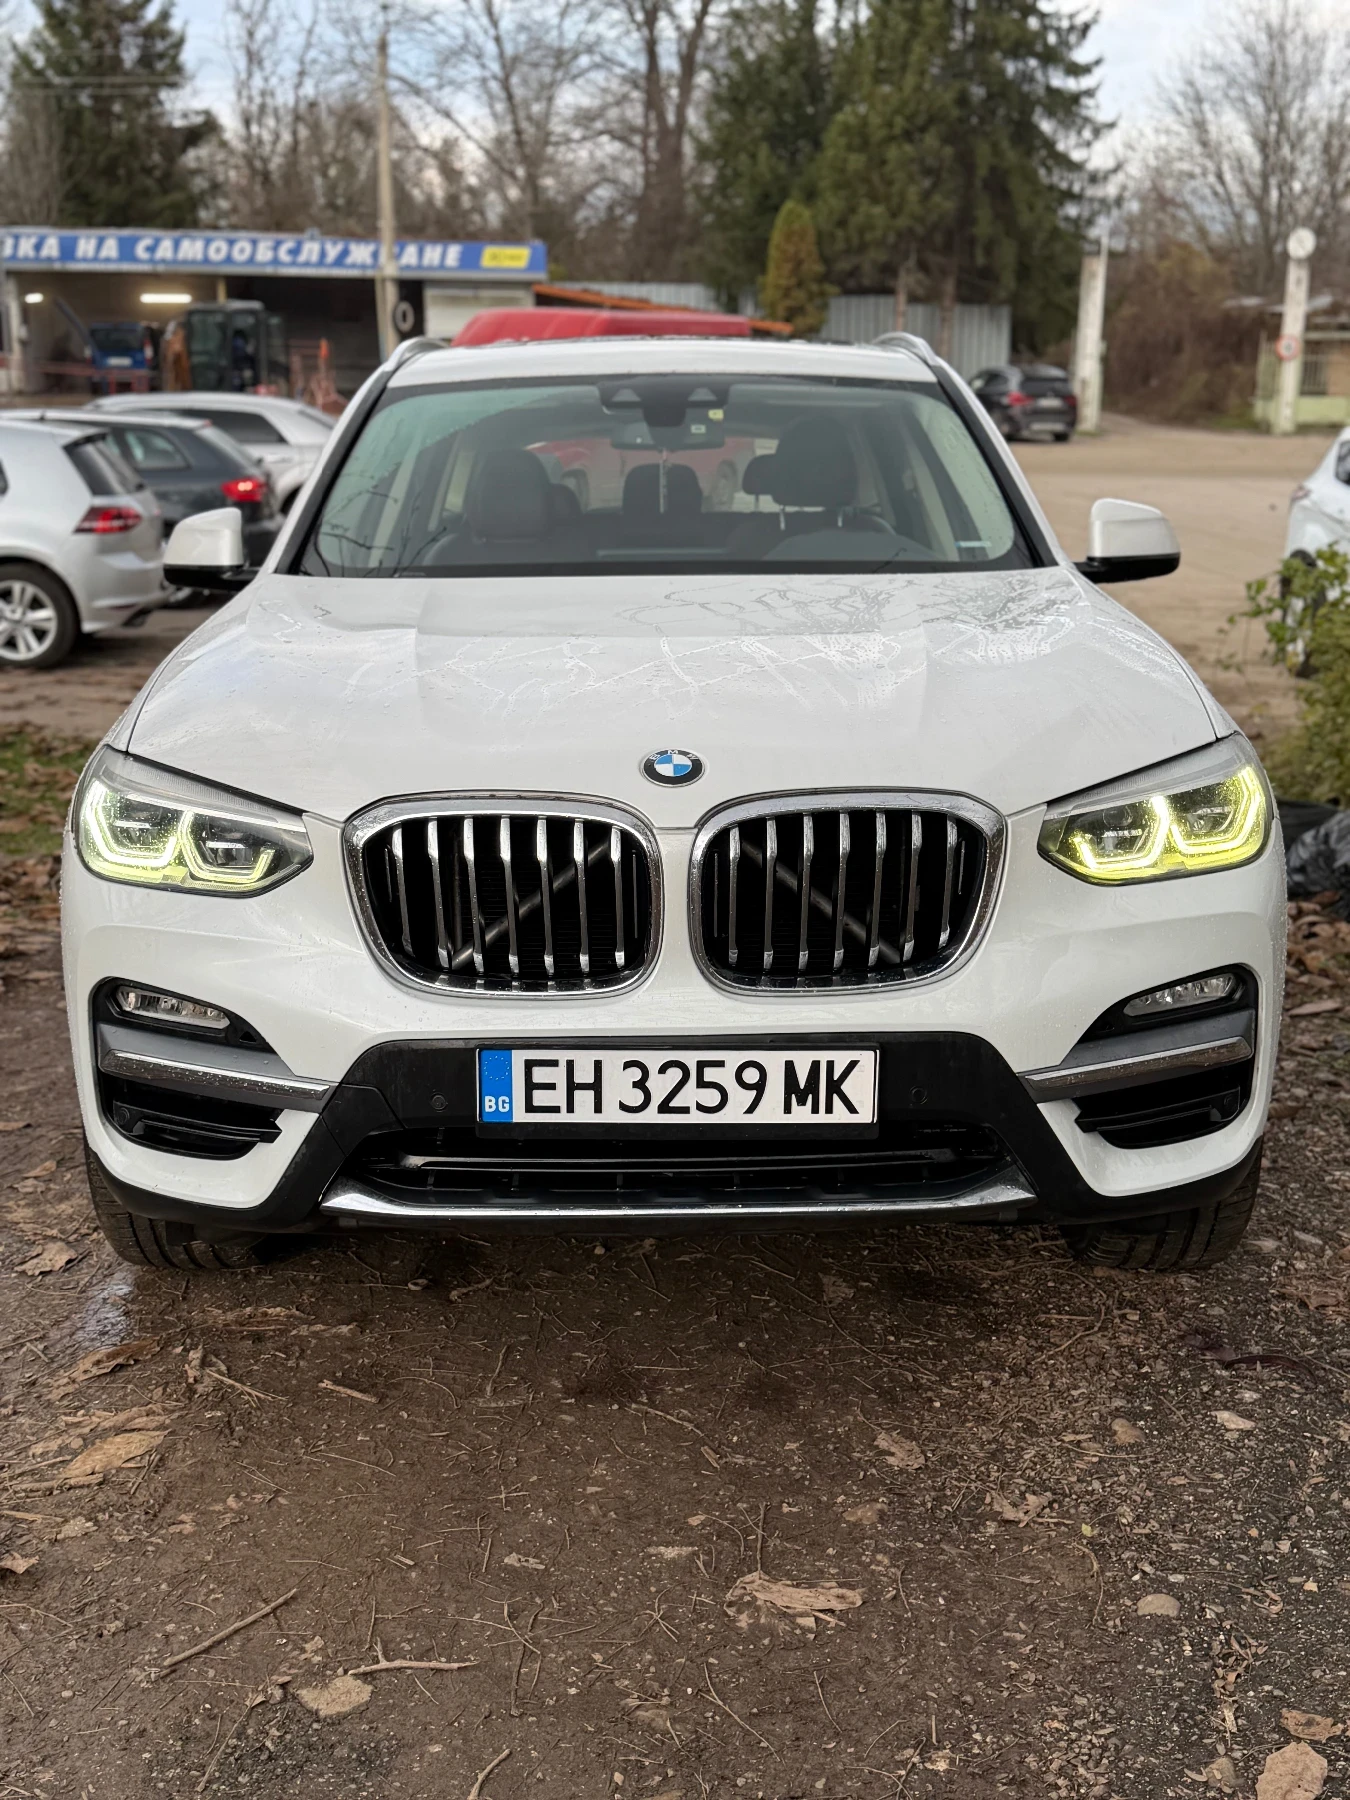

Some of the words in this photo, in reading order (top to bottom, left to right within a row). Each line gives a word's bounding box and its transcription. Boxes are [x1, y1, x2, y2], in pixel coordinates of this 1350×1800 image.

[75, 237, 119, 260] НА
[524, 1059, 603, 1114] EH
[618, 1059, 768, 1114] 3259
[784, 1059, 860, 1114] MK
[484, 1095, 510, 1113] BG
